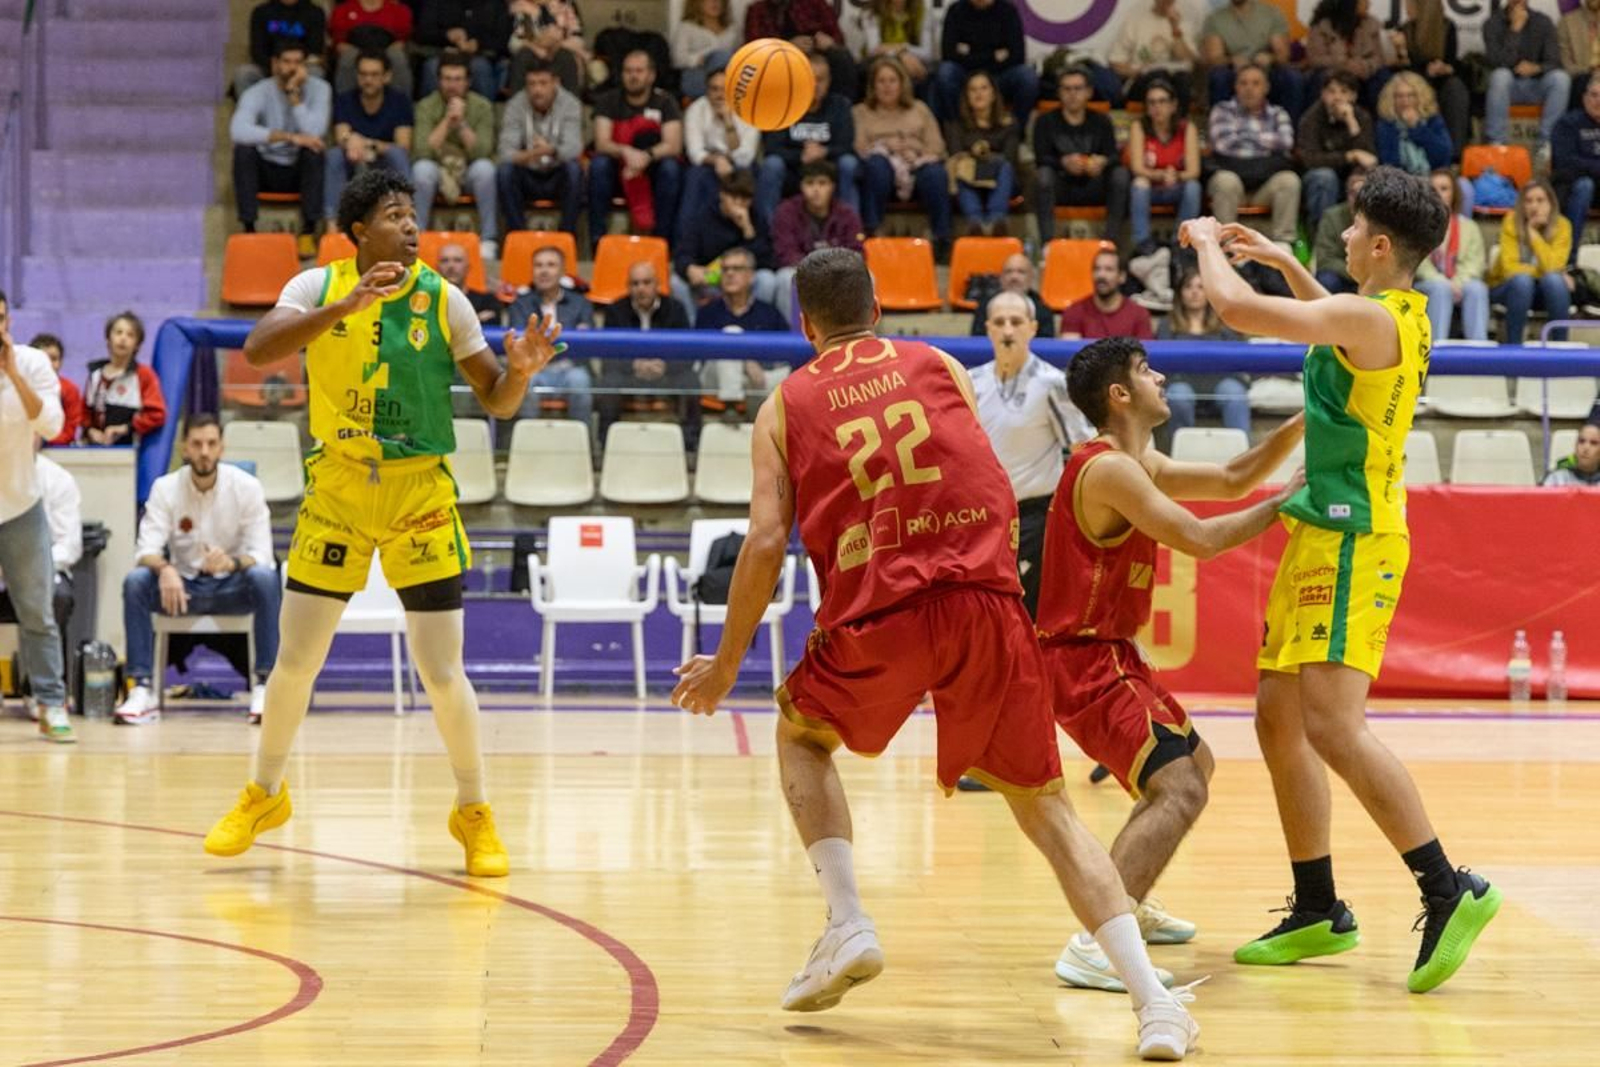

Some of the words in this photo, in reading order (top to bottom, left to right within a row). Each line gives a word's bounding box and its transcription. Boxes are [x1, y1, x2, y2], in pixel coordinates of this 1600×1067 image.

[733, 64, 757, 113] Wils
[372, 321, 383, 346] 3
[345, 388, 401, 418] Jaén
[827, 370, 908, 412] JUANMA
[1382, 374, 1405, 428] RUSTER
[835, 400, 943, 501] 22
[944, 507, 988, 528] ACM
[839, 536, 869, 557] UNED
